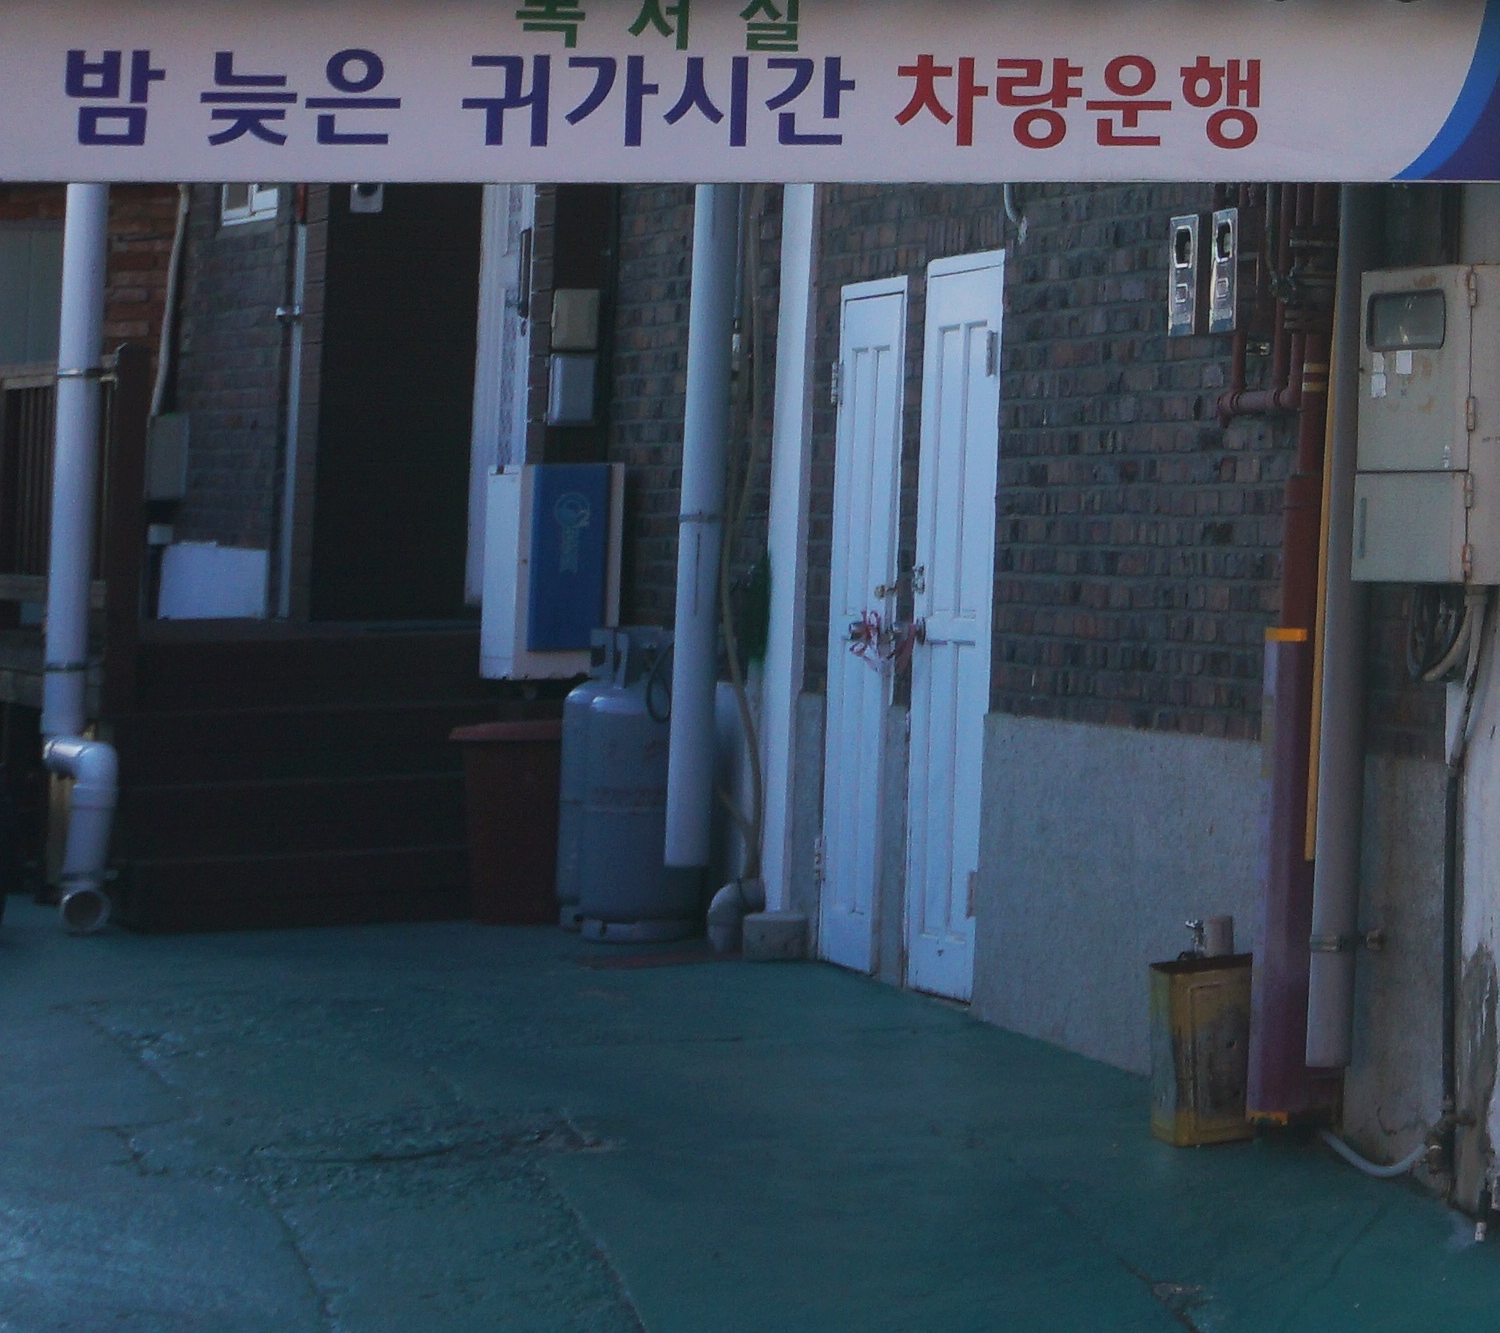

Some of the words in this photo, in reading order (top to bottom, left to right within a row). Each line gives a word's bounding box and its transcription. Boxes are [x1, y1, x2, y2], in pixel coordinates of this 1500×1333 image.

[65, 48, 166, 148] 밤
[200, 48, 402, 147] 늦은
[462, 53, 856, 148] 귀가시간
[895, 53, 1262, 151] 차량운행
